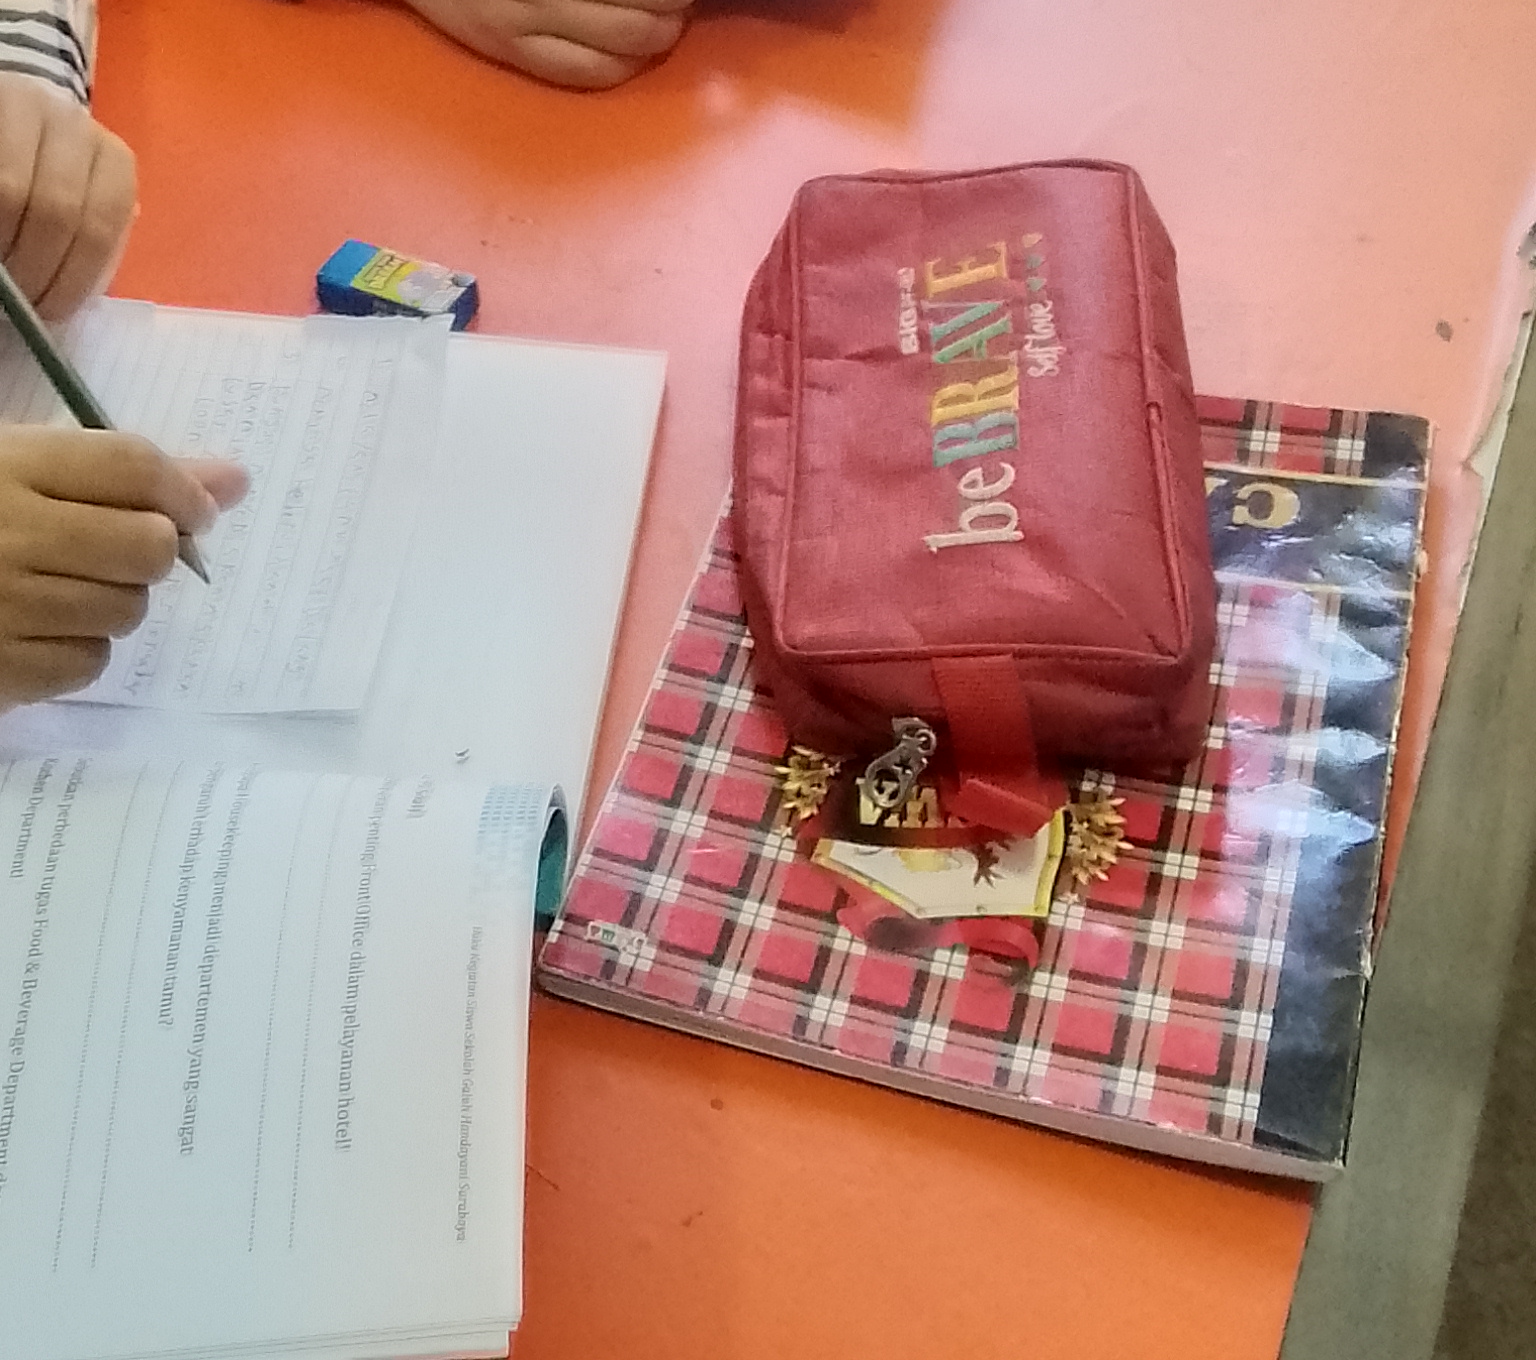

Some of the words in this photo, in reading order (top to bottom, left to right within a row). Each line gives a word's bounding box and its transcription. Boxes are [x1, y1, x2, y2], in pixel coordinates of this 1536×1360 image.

[922, 240, 1021, 467] BRAVE
[7, 797, 45, 879] Department!
[42, 804, 74, 873] perbedaan
[177, 815, 206, 873] terhadap
[213, 794, 250, 879] Housekeeping
[359, 816, 382, 860] penting
[33, 876, 56, 915] tugas
[203, 881, 226, 941] menjadi
[356, 864, 377, 901] Front
[25, 918, 50, 958] Food
[163, 876, 196, 972] kenyamanan
[350, 905, 371, 946] Office
[23, 961, 41, 975] &
[191, 945, 221, 1044] departemen
[345, 952, 366, 1000] dalam
[7, 978, 39, 1056] Beverage
[156, 975, 179, 1027] tamu?
[182, 1048, 203, 1091] yang
[336, 1005, 361, 1093] pelayanan
[461, 1032, 475, 1075] Sekolah
[176, 1095, 198, 1156] sangat
[333, 1097, 356, 1150] hotel!
[456, 1115, 473, 1180] Handayani
[453, 1183, 471, 1242] Surabaya
